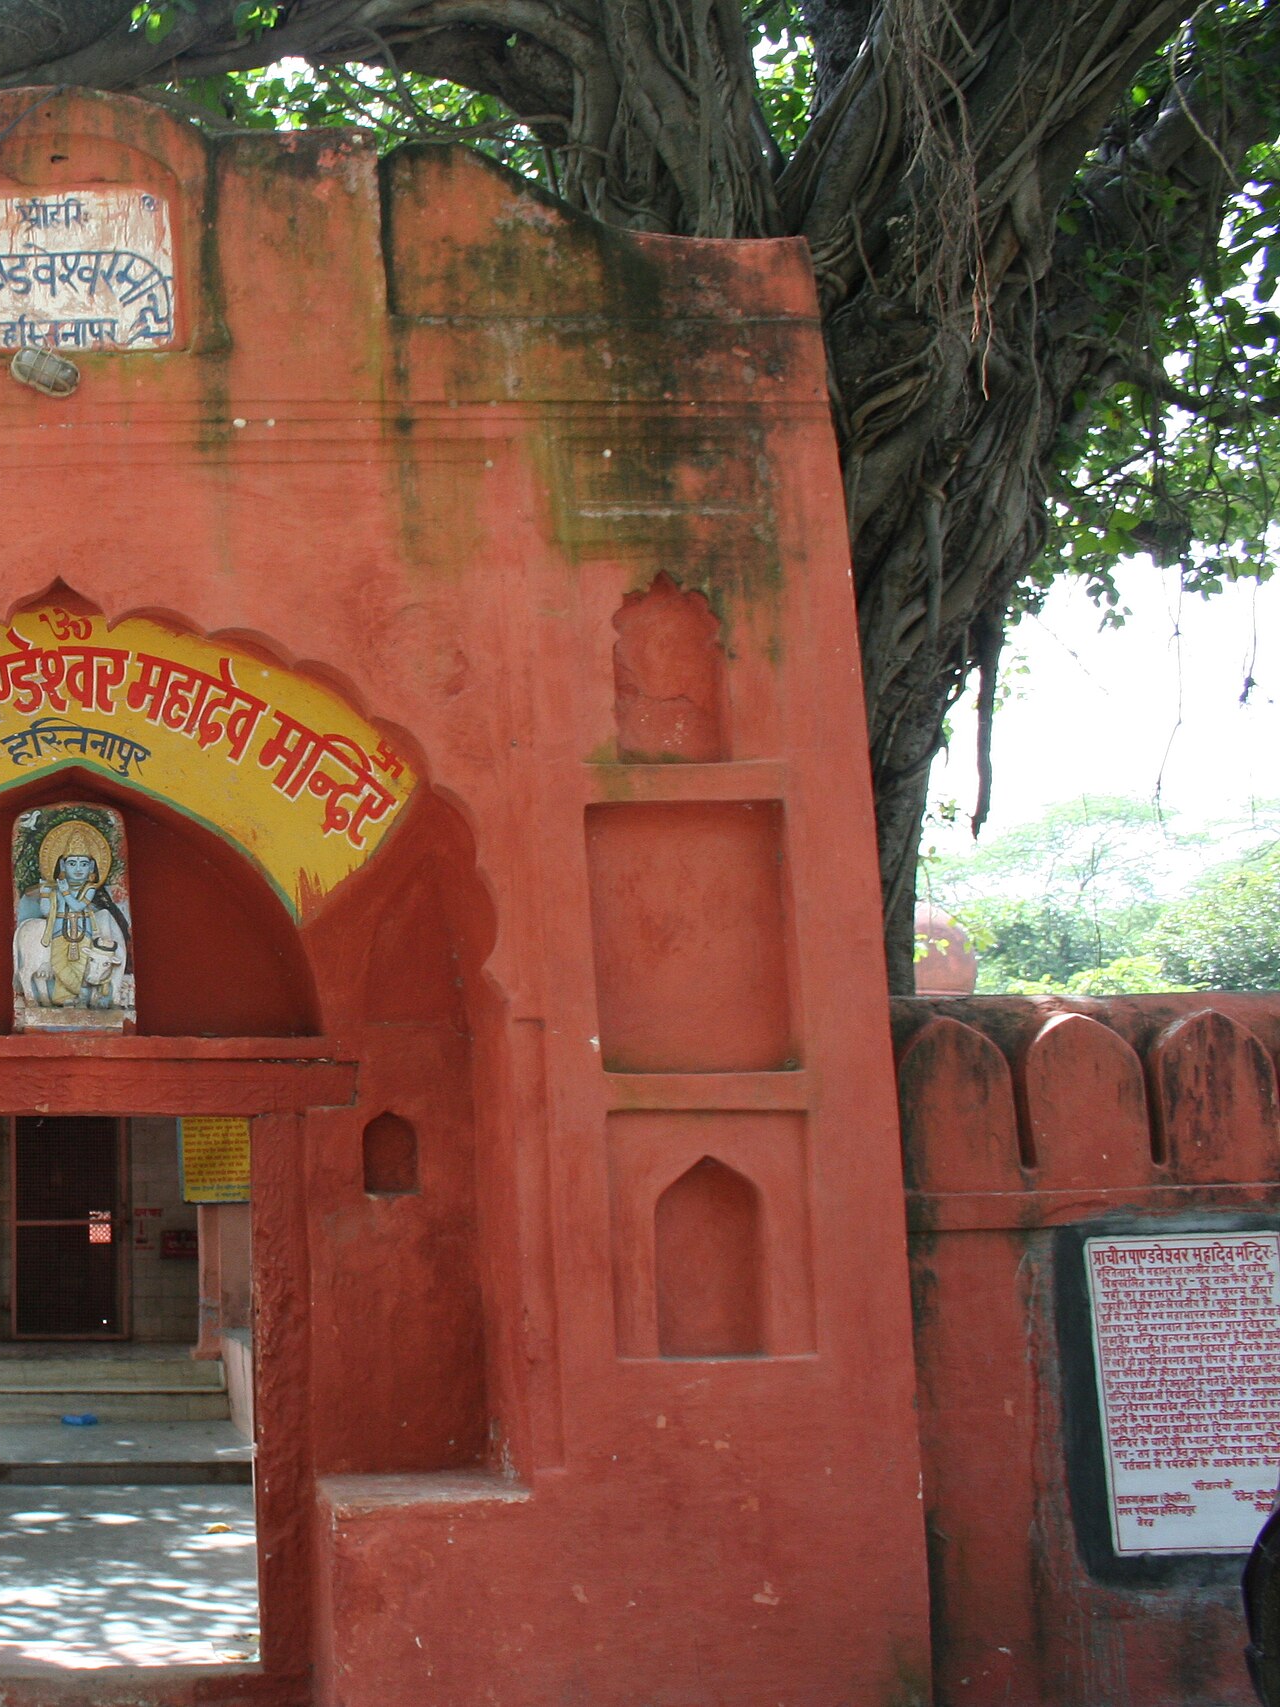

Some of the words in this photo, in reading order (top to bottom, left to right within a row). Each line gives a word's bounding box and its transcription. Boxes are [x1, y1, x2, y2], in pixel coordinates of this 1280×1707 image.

[0, 717, 152, 777] हस्तिनापुर
[127, 658, 270, 765] महादेव
[258, 710, 398, 849] मन्दिर
